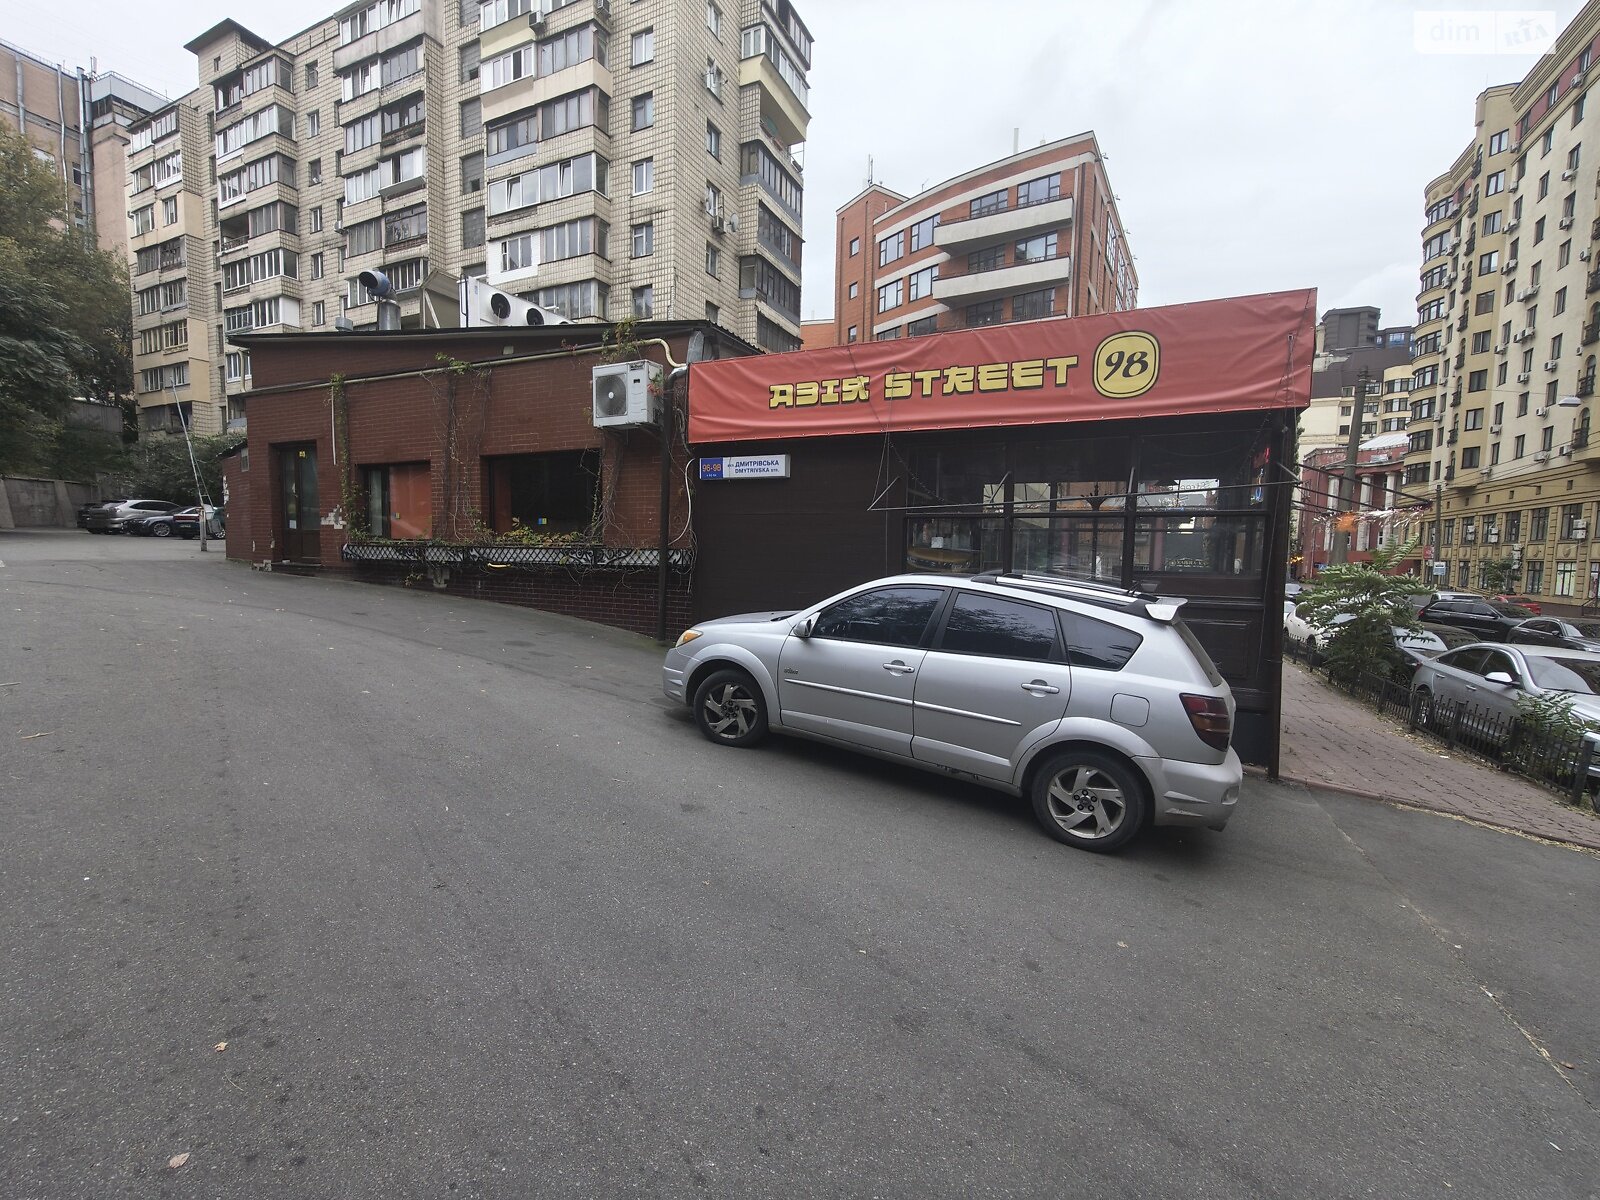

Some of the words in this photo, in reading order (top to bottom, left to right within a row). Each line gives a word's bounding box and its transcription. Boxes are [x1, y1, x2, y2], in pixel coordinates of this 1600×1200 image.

[884, 355, 1079, 401] STREET
[1103, 349, 1150, 380] 98
[735, 460, 779, 468] ДМИТРІВСЬКА
